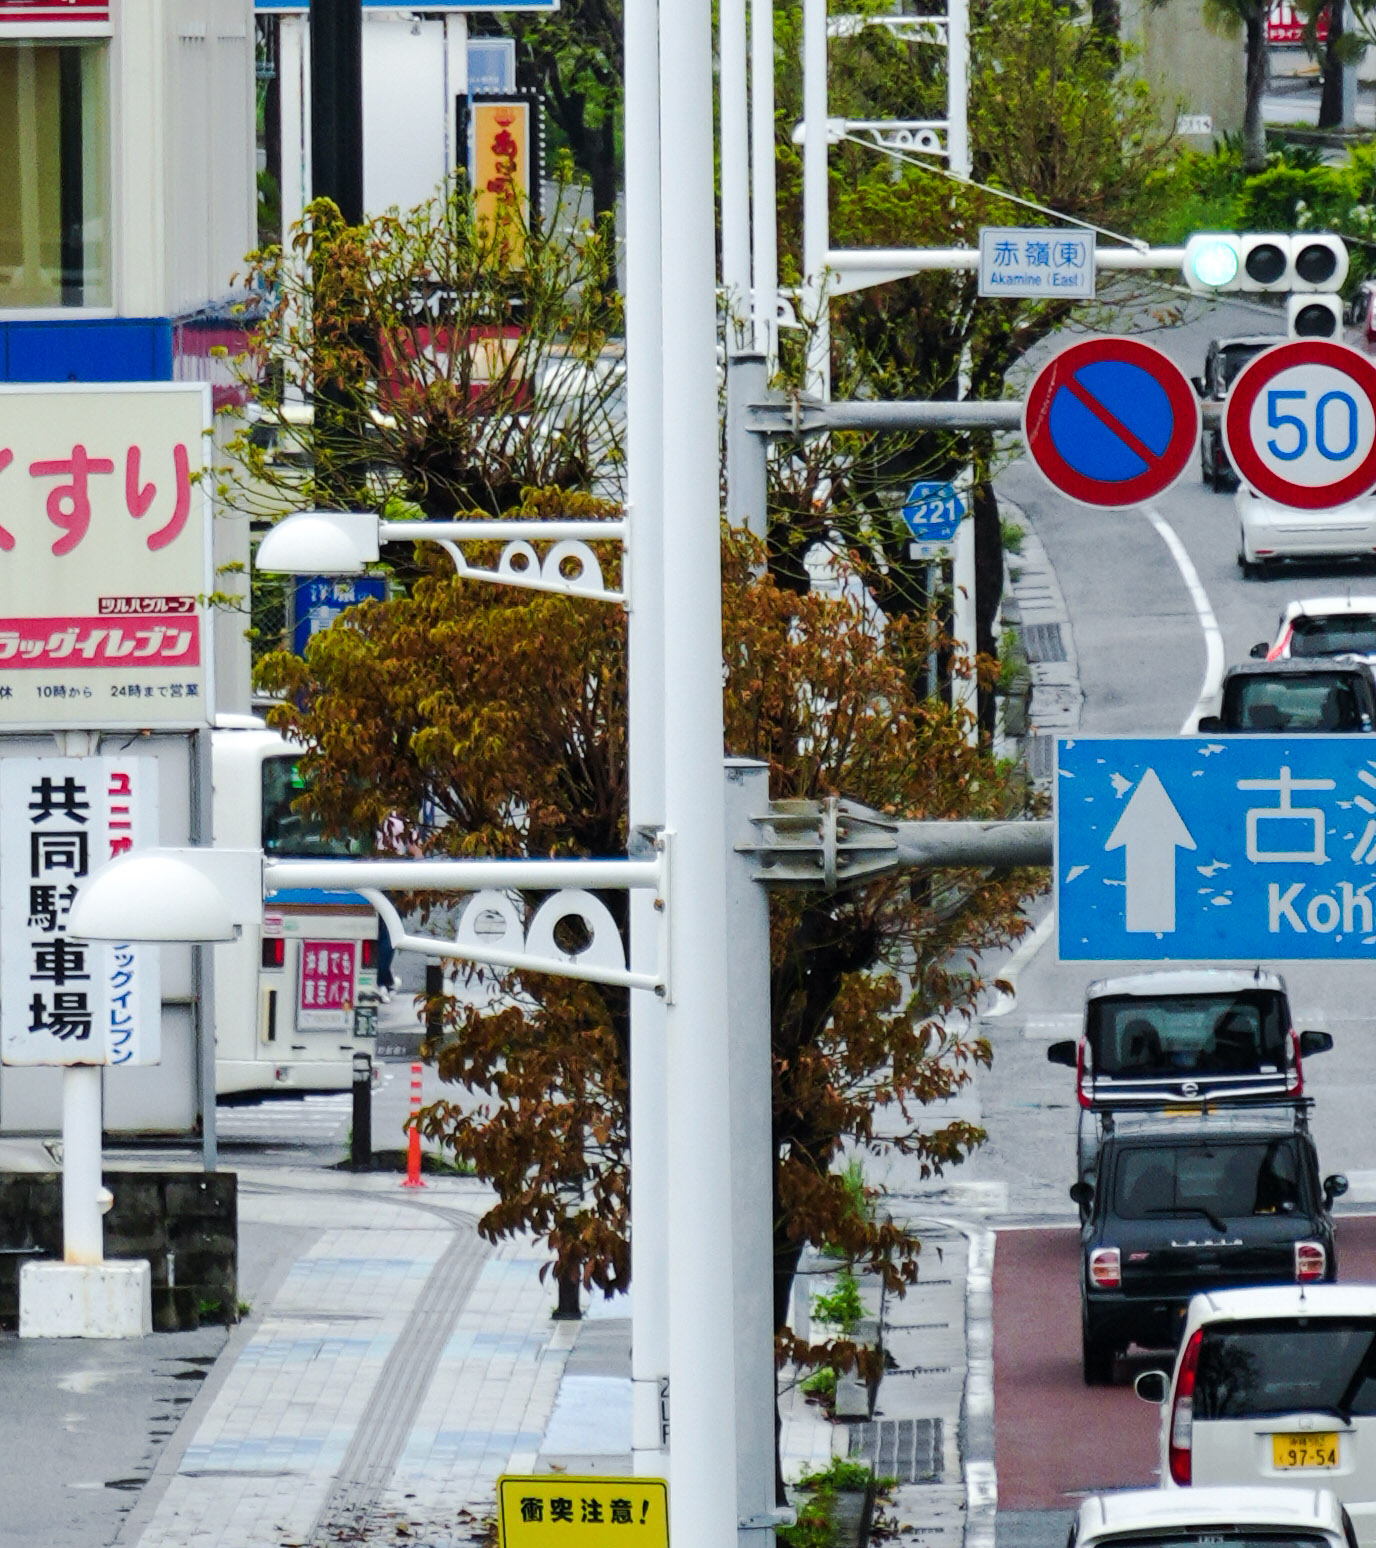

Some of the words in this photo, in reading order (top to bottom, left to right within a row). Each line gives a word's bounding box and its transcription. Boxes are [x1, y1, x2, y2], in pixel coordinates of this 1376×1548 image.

[994, 241, 1086, 269] 赤嶺(東)
[991, 273, 1042, 286] Akamine
[1047, 272, 1084, 287] (East)
[1266, 390, 1358, 461] 50
[913, 500, 956, 524] 221
[101, 598, 195, 614] ツルハグループ
[36, 685, 93, 699] 10時から
[111, 683, 200, 699] 24時まで営業
[1287, 1450, 1336, 1466] 97-54
[520, 1496, 650, 1525] 衝突注意!
